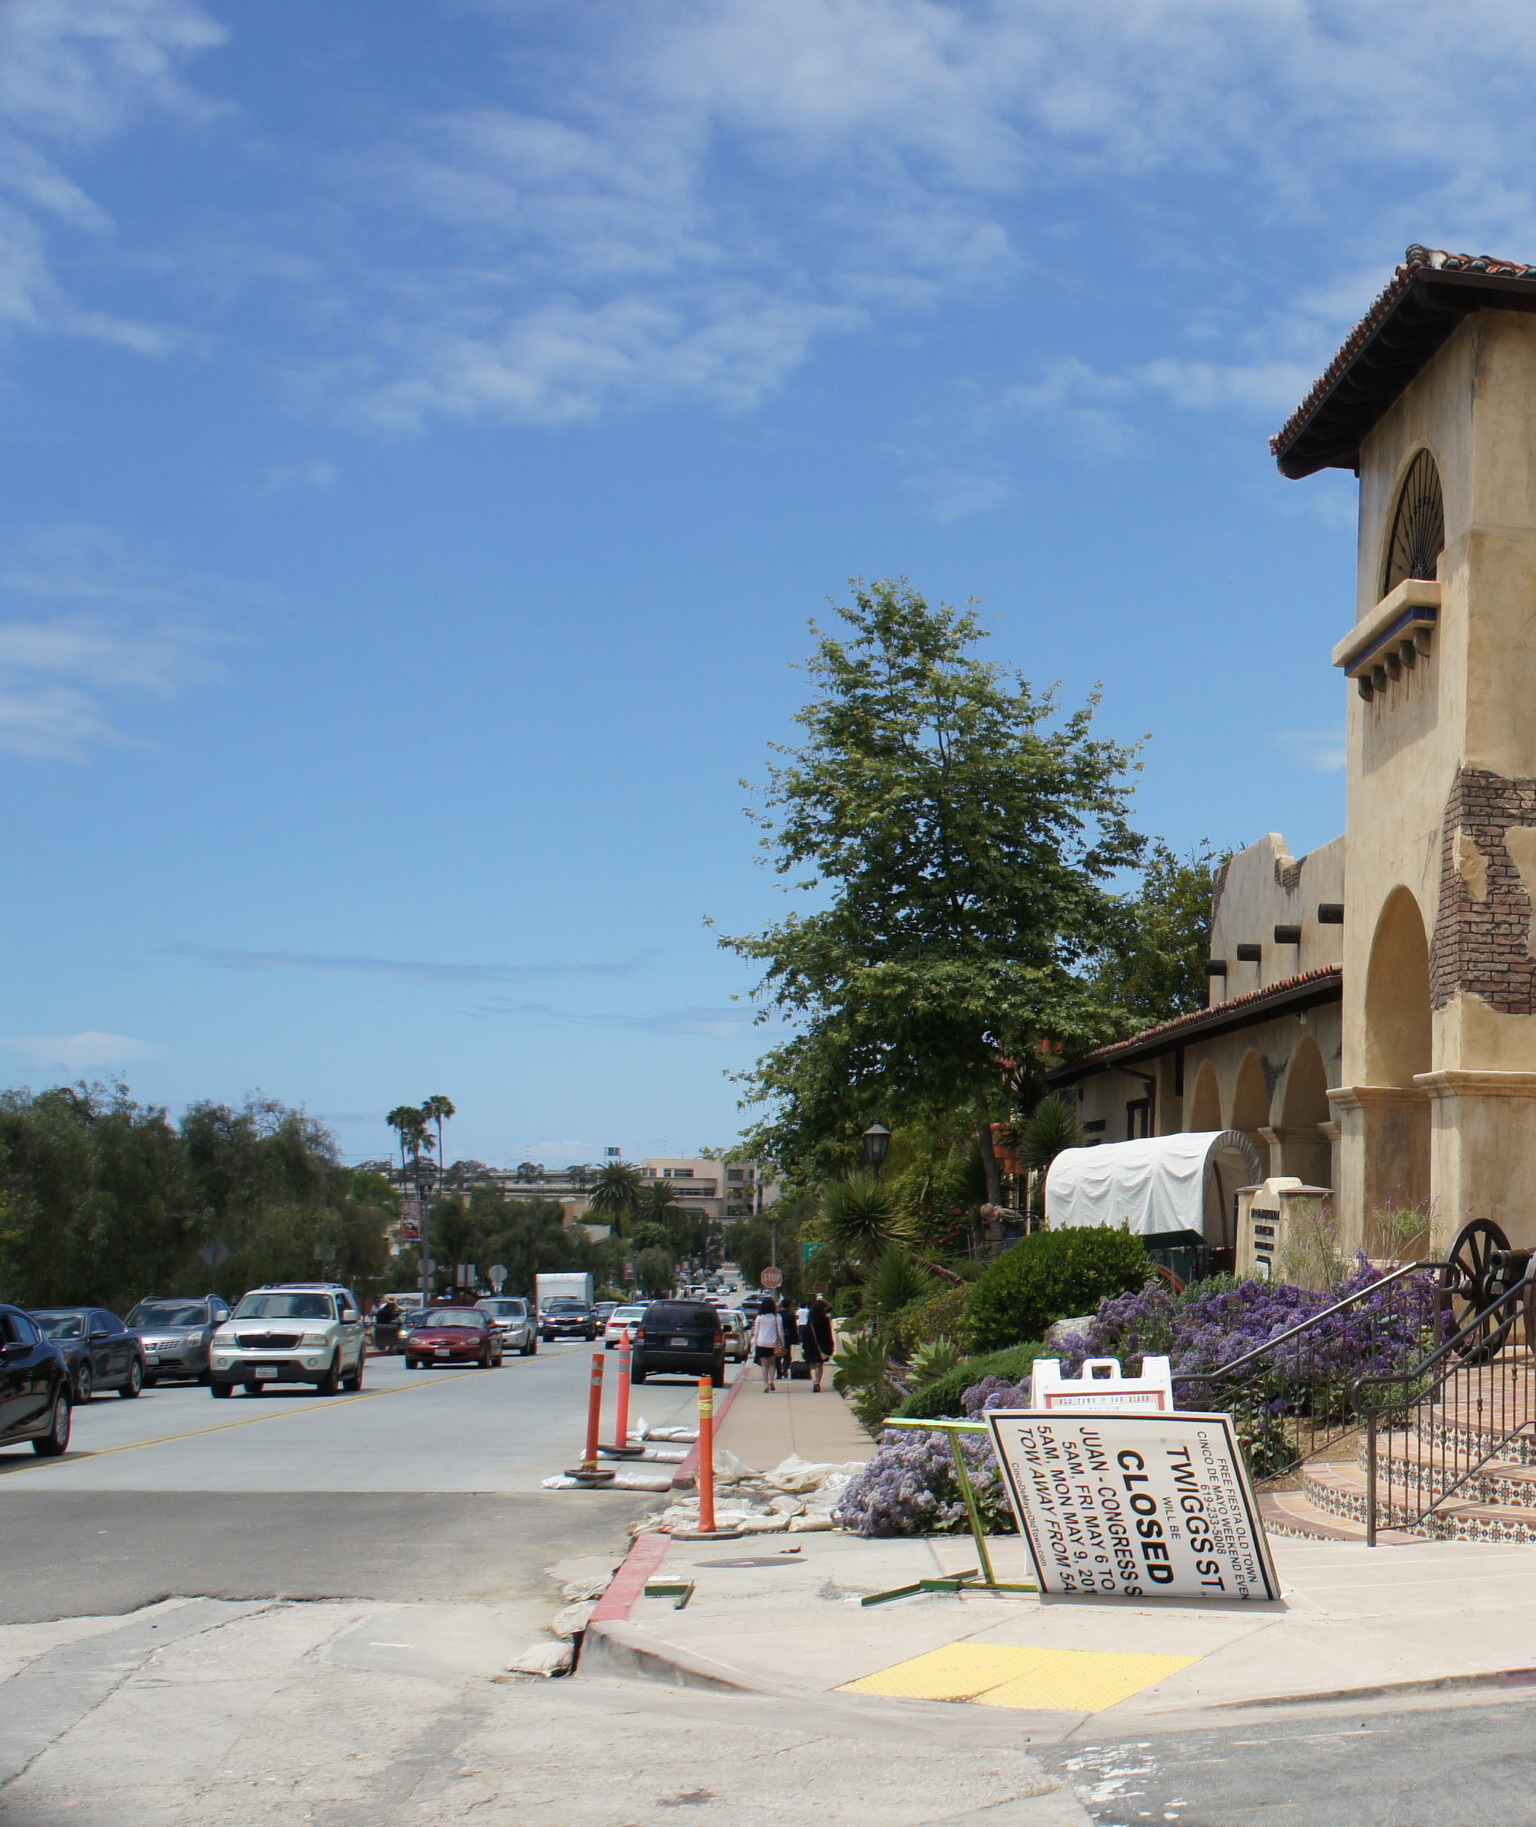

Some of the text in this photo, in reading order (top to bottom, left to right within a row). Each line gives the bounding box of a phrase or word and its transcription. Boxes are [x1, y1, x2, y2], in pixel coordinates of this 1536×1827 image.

[763, 1273, 781, 1282] STOP
[1037, 1425, 1060, 1464] 5AM,
[1197, 1431, 1214, 1465] CINCO
[1050, 1469, 1074, 1506] MON
[1207, 1467, 1219, 1482] DE
[1011, 1462, 1047, 1567] CincoDeMayoOldTown.com
[1017, 1428, 1077, 1594] TOW AWAY FROM 5A
[1062, 1441, 1116, 1591] 5AM, FRI MAY 6 TO
[1079, 1427, 1109, 1471] JUAN
[1097, 1487, 1139, 1581] CONGRESS
[1117, 1450, 1174, 1584] CLOSED
[1162, 1496, 1181, 1540] WILL BE
[1166, 1445, 1225, 1591] TWIGGS ST
[1200, 1484, 1227, 1555] 619-233-5008
[1211, 1485, 1228, 1515] MAYO
[1217, 1458, 1258, 1583] FREE FIESTA OLD TOWN
[1062, 1512, 1085, 1546] MAY
[1221, 1517, 1242, 1571] WEEKEND
[1073, 1550, 1088, 1564] 9,
